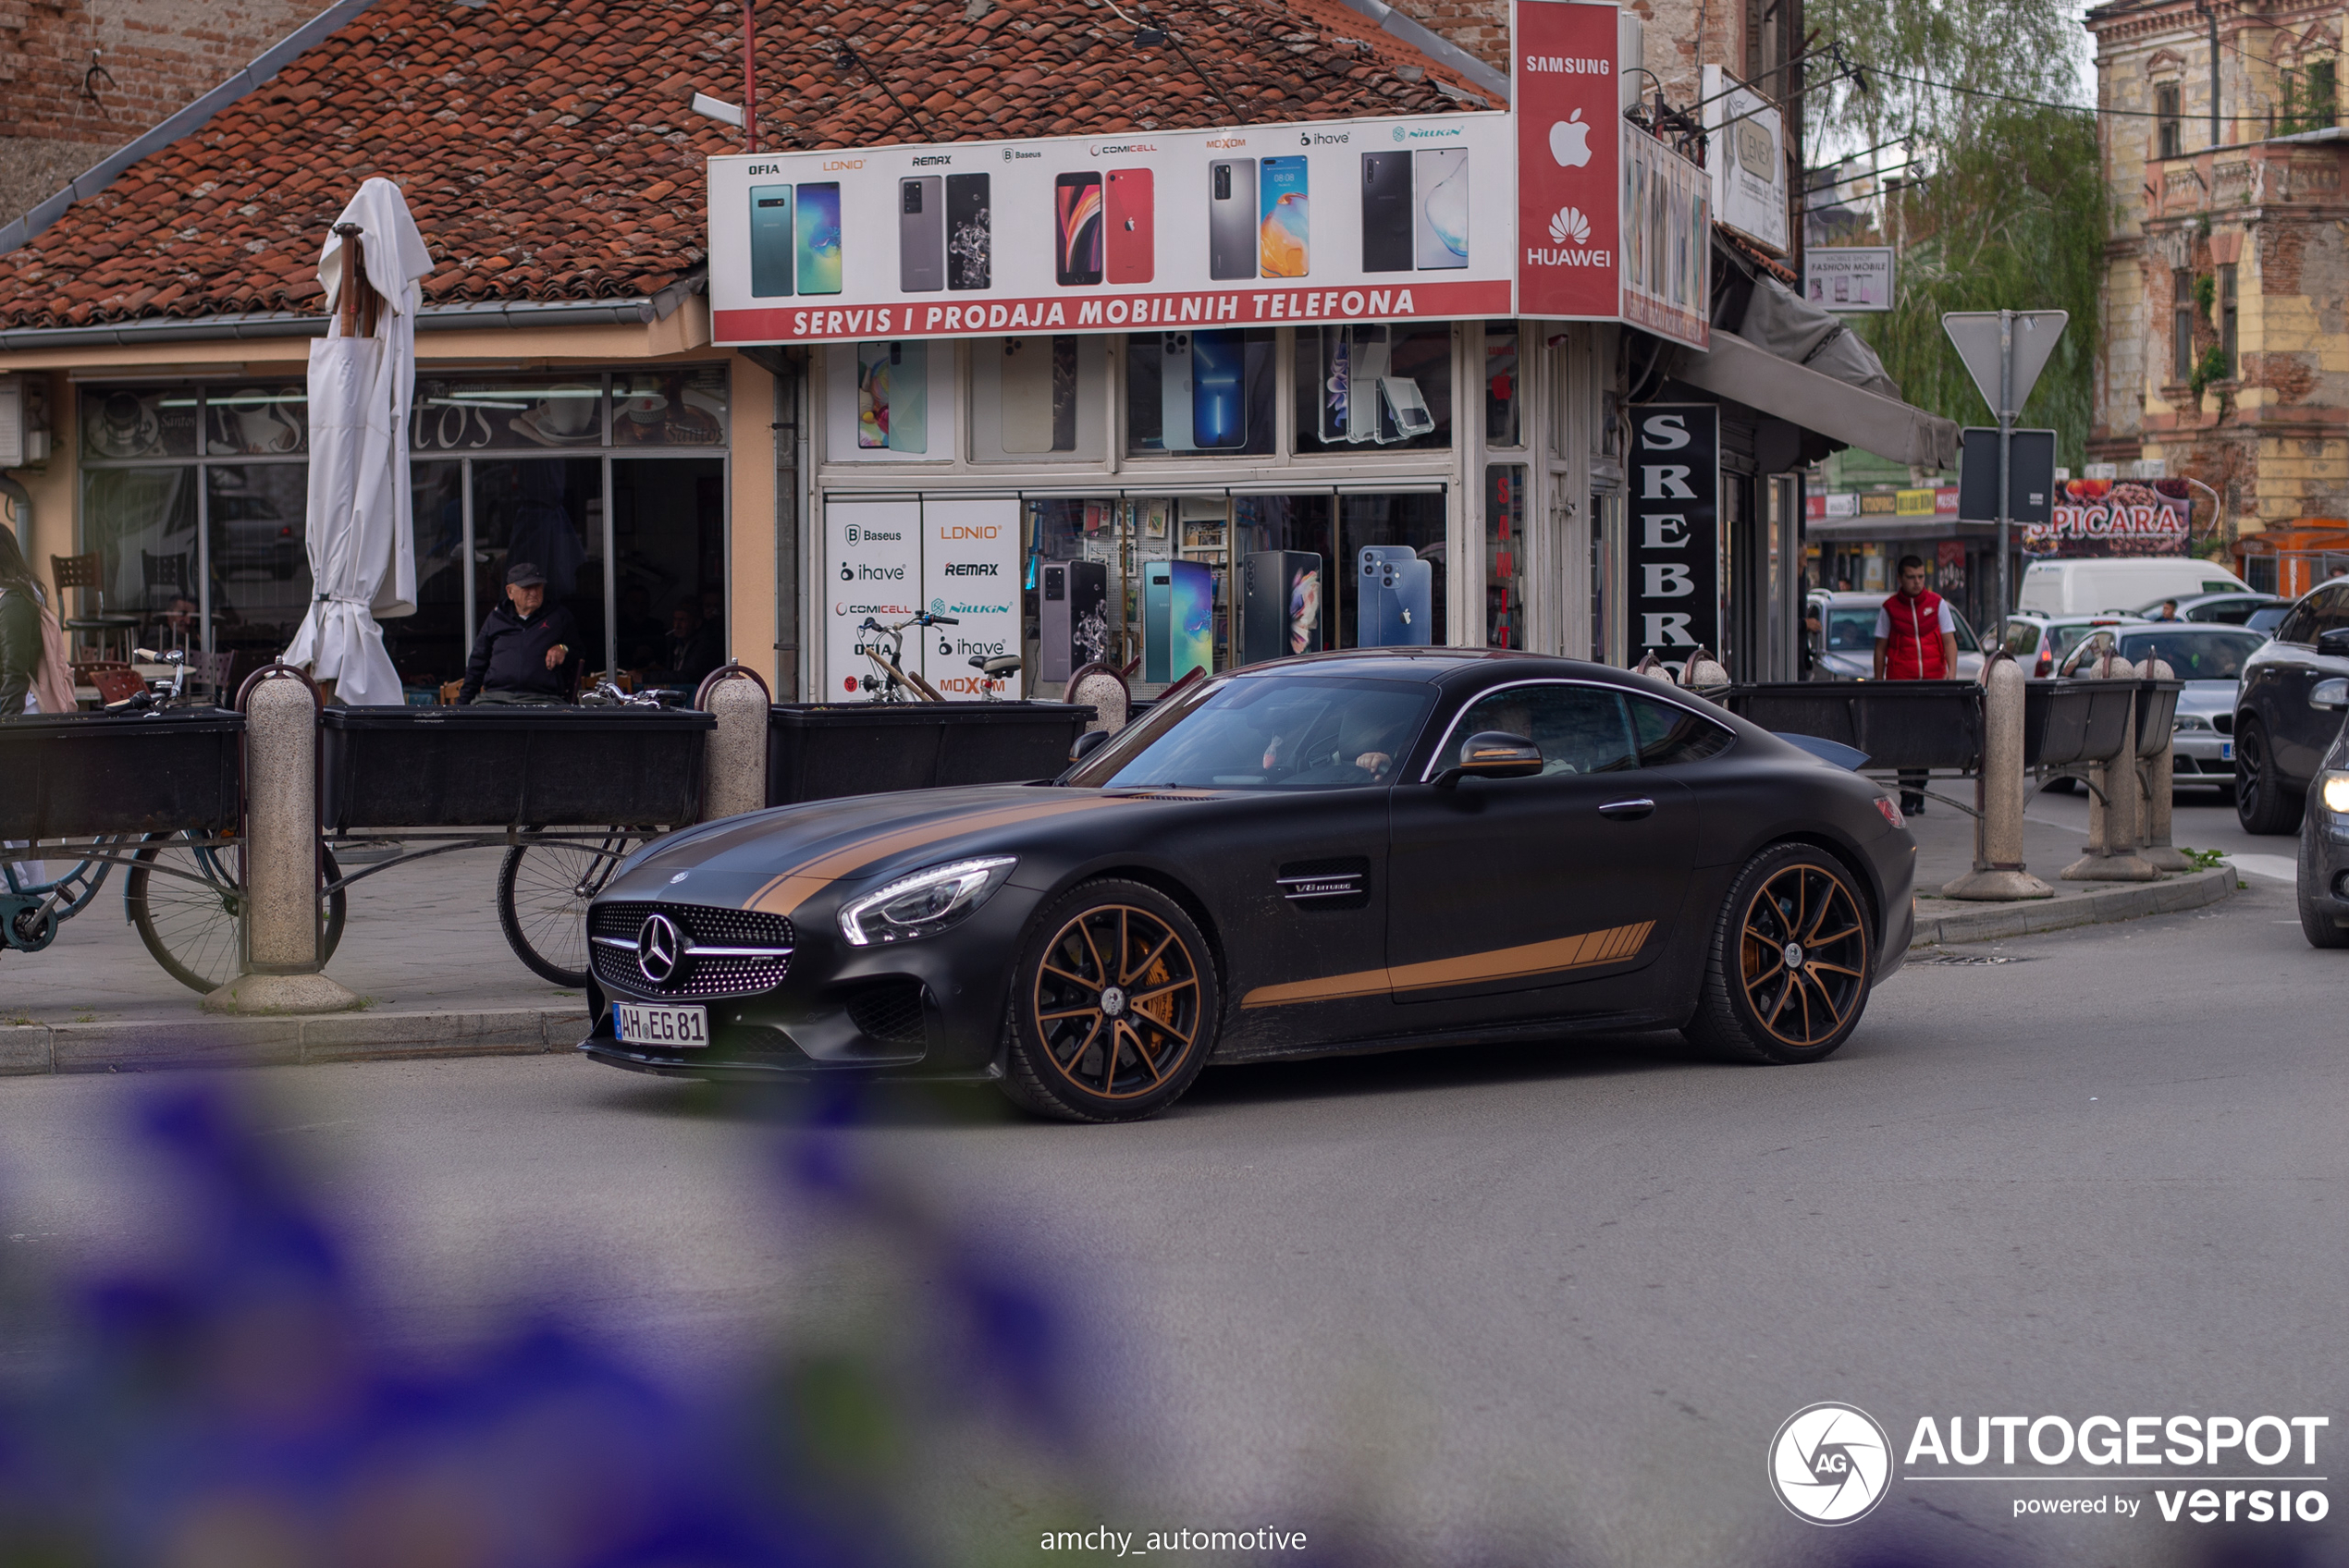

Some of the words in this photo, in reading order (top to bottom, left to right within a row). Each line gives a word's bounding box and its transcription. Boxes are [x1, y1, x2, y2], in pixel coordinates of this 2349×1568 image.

[1526, 55, 1610, 76] SAMSUNG
[1206, 138, 1246, 149] MOXOM
[1313, 132, 1349, 145] ihave
[1015, 151, 1041, 159] Baseus
[1102, 144, 1158, 154] COMICELL
[823, 160, 864, 172] LDNIO
[912, 155, 952, 166] REMAX
[748, 164, 781, 176] OFIA
[1527, 248, 1611, 268] HUAWEI
[1811, 263, 1851, 272] FASHION
[1853, 263, 1887, 271] MOBILE
[793, 308, 892, 336] SERVIS
[904, 307, 914, 331] I
[926, 301, 1066, 330] PRODAJA
[1077, 296, 1238, 325] MOBILNIH
[1252, 289, 1416, 318] TELEFONA
[666, 423, 724, 445] Santos
[864, 530, 902, 541] Baseus
[941, 526, 997, 540] LDNIO
[858, 564, 904, 581] ihave
[944, 562, 999, 576] REMAX
[849, 605, 912, 614] COMICELL
[957, 638, 1004, 655] ihave
[1296, 884, 1316, 892] V8
[1316, 883, 1351, 891] BITURBO
[622, 1009, 641, 1038] AH
[649, 1011, 674, 1040] EG
[677, 1012, 705, 1041] 81
